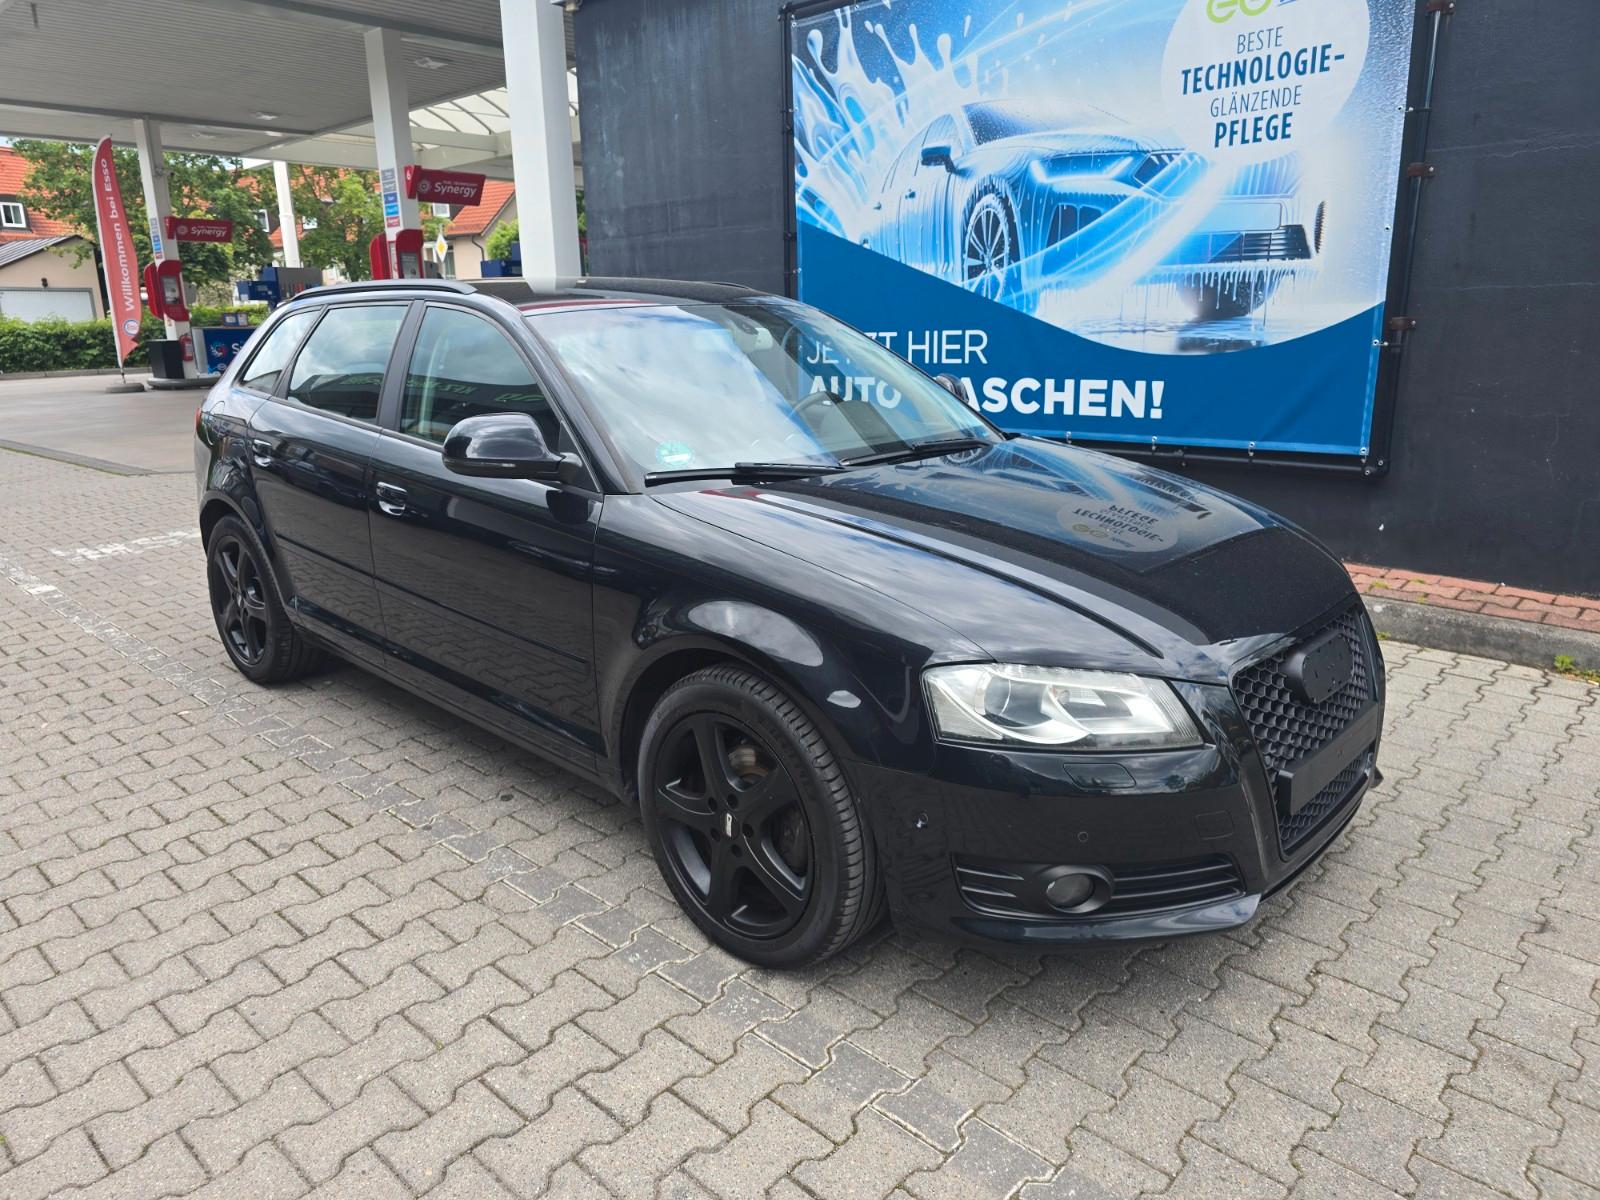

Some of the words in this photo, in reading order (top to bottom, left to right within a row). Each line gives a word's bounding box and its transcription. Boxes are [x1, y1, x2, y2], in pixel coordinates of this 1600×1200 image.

[1236, 26, 1284, 54] BESTE
[1181, 43, 1345, 95] TECHNOLOGIE-
[1210, 85, 1303, 118] GLÄNZENDE
[1214, 112, 1293, 148] PFLEGE
[433, 181, 478, 198] Synergy
[106, 196, 119, 219] bei
[190, 226, 228, 238] Synergy
[113, 223, 135, 311] Willkommen
[806, 331, 898, 364] JET
[907, 330, 988, 364] HIER
[804, 375, 902, 409] AUTO
[934, 374, 1165, 419] ASCHEN!
